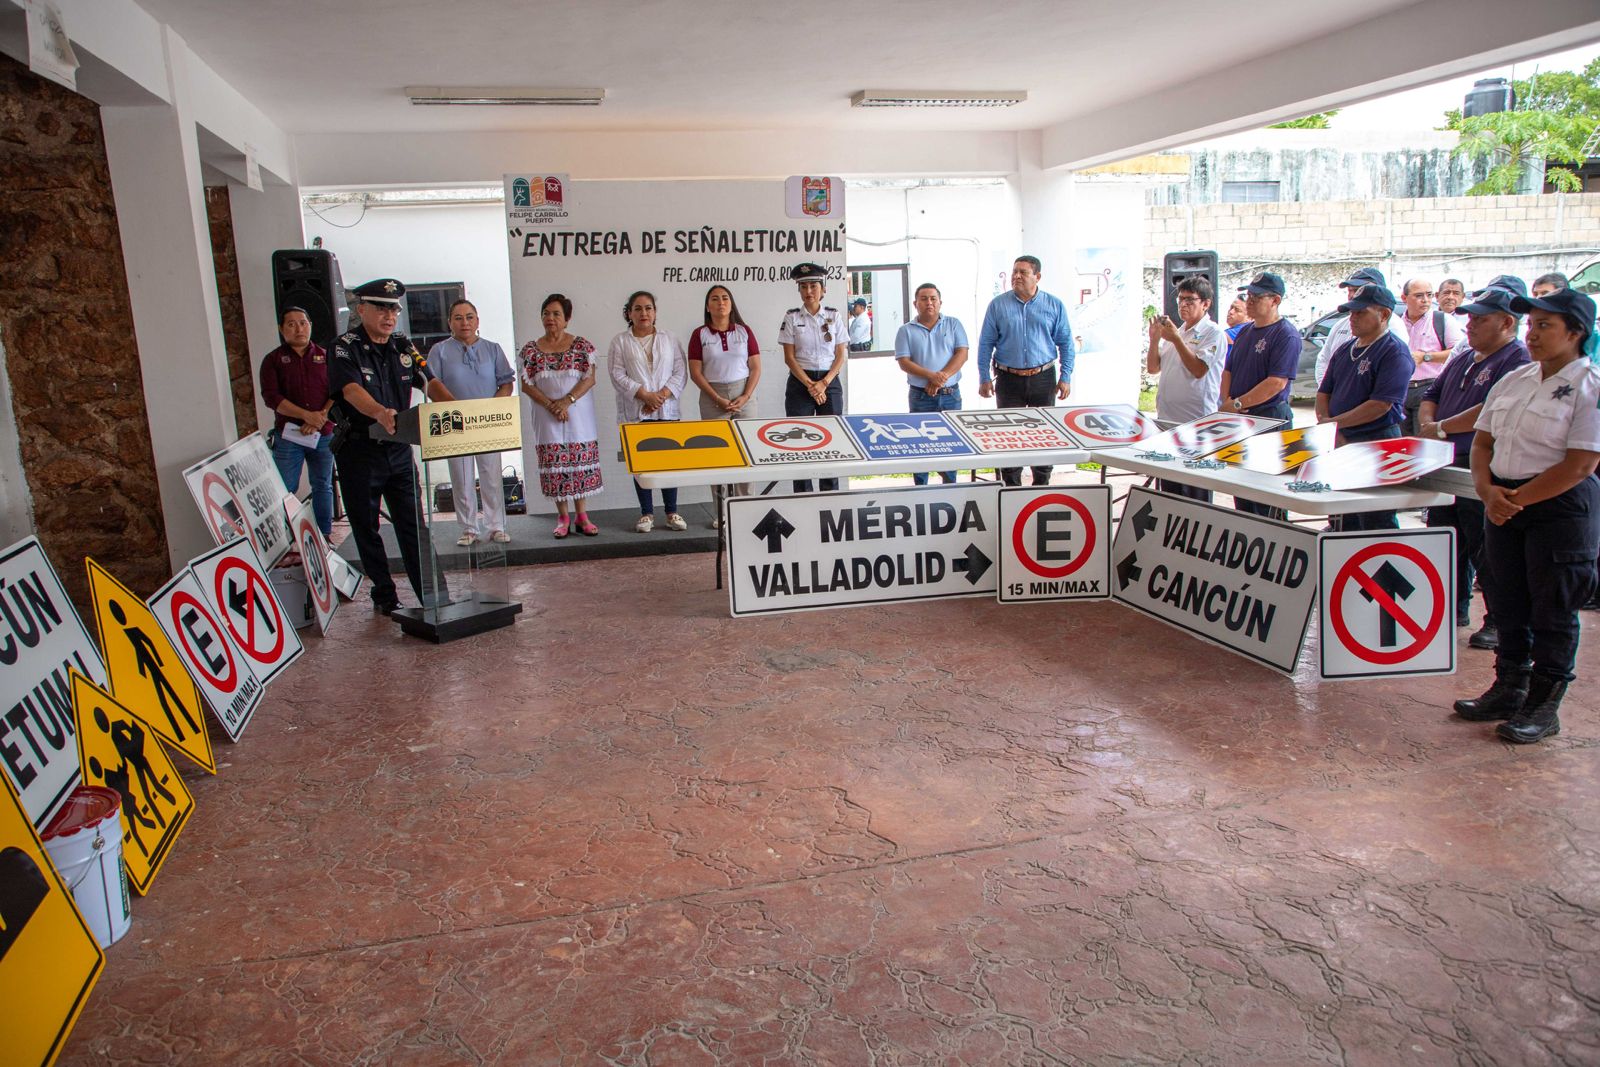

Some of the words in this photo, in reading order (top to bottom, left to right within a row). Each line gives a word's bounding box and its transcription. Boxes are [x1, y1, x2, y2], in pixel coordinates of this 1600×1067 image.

[641, 231, 667, 254] DE
[674, 225, 798, 253] SEÑALETICA
[663, 267, 687, 283] FPE.
[690, 267, 739, 282] CARRILLO
[464, 416, 477, 424] UN
[479, 412, 513, 422] PUEBLO
[1083, 413, 1128, 431] 40
[918, 441, 964, 449] DESCENSO
[972, 428, 1055, 439] SERVICIO
[759, 453, 856, 463] MOTOCICLETAS
[770, 449, 841, 458] EXCLUSIVO
[818, 500, 987, 543] MÉRIDA
[1036, 511, 1072, 561] E
[254, 520, 274, 553] DE
[1161, 512, 1310, 590] VALLADOLID
[304, 535, 323, 585] 30
[747, 550, 946, 599] VALLADOLID
[1007, 583, 1024, 596] 15
[1029, 580, 1100, 595] MIN/MAX
[1147, 563, 1275, 644] CANCÚN
[181, 608, 227, 676] E
[230, 674, 259, 718] MIN/MAX
[224, 708, 237, 727] 10
